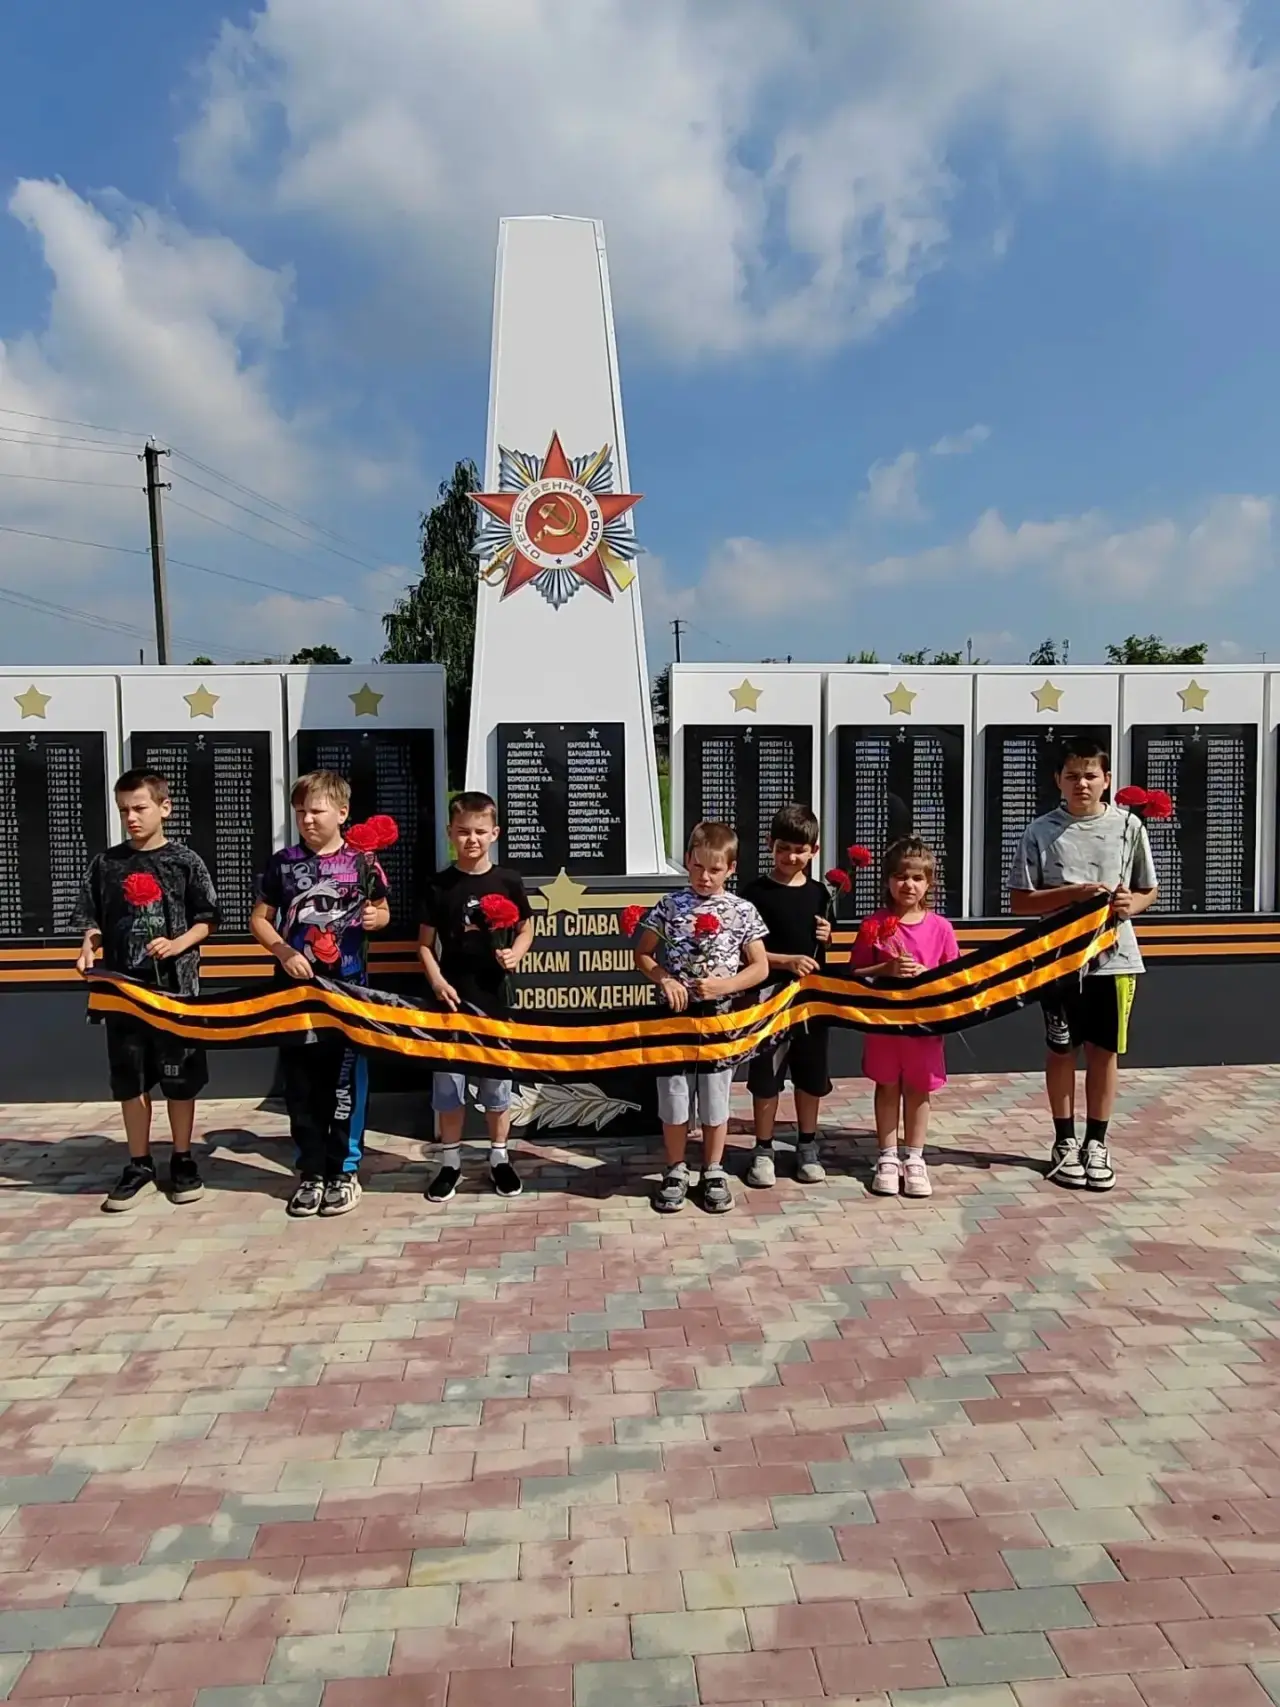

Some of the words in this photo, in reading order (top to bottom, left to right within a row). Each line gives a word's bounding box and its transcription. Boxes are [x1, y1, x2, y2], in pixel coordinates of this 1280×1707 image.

[515, 481, 593, 560] ОТЕЧЕСТВЕННАЯ
[564, 914, 620, 936] СЛАВА
[515, 984, 656, 1010] ОСВОБОЖДЕНИЕ
